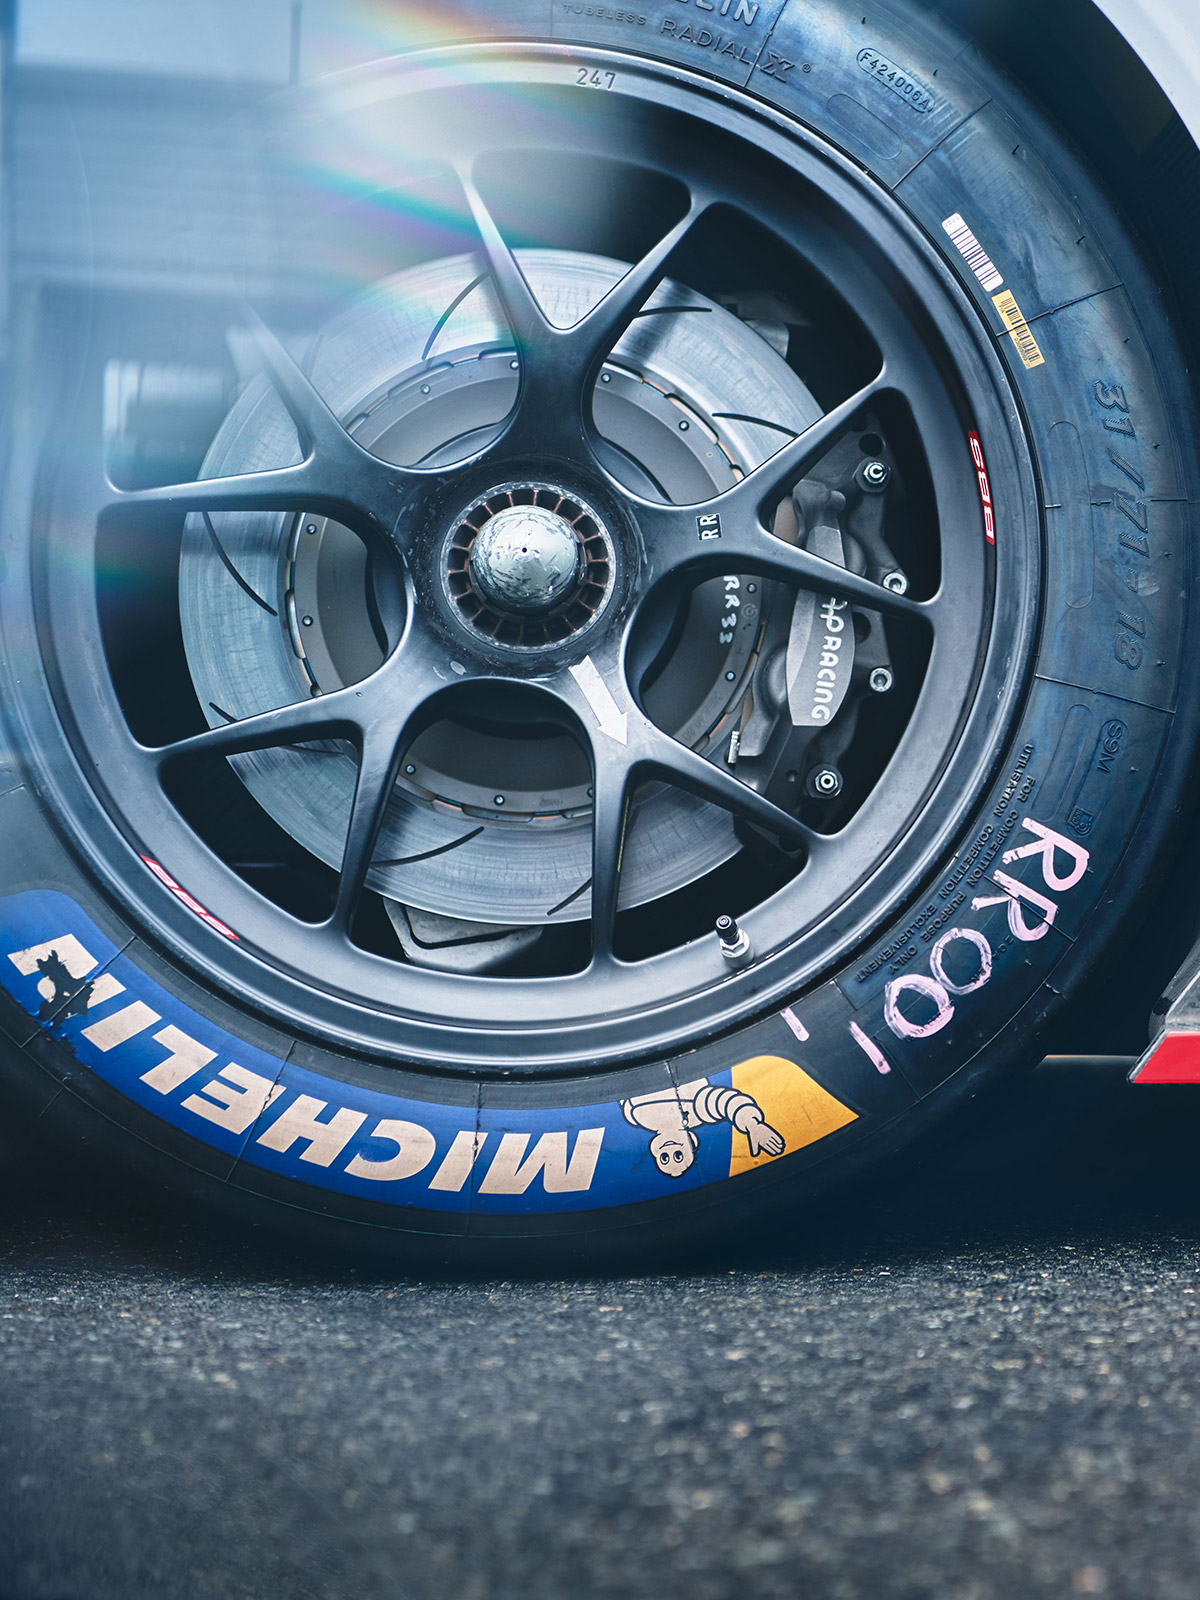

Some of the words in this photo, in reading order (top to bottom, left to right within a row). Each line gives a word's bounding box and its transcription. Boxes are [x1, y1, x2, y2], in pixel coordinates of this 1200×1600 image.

[562, 3, 648, 26] TUBELESS
[659, 18, 752, 65] RADIAL
[576, 67, 618, 90] 247
[859, 52, 930, 110] F424006A
[969, 437, 995, 540] BBS
[699, 513, 720, 540] RR
[1097, 721, 1123, 774] S9M
[992, 743, 1034, 818] UTILISATION
[1017, 774, 1036, 804] FOR
[938, 823, 994, 900] COMPETITION
[965, 809, 1020, 888] COMPETITION
[144, 860, 235, 937] BBS
[922, 890, 966, 943] PURPOSE
[856, 903, 938, 984] EXCLUSIVEMENT
[887, 946, 918, 976] ONLY
